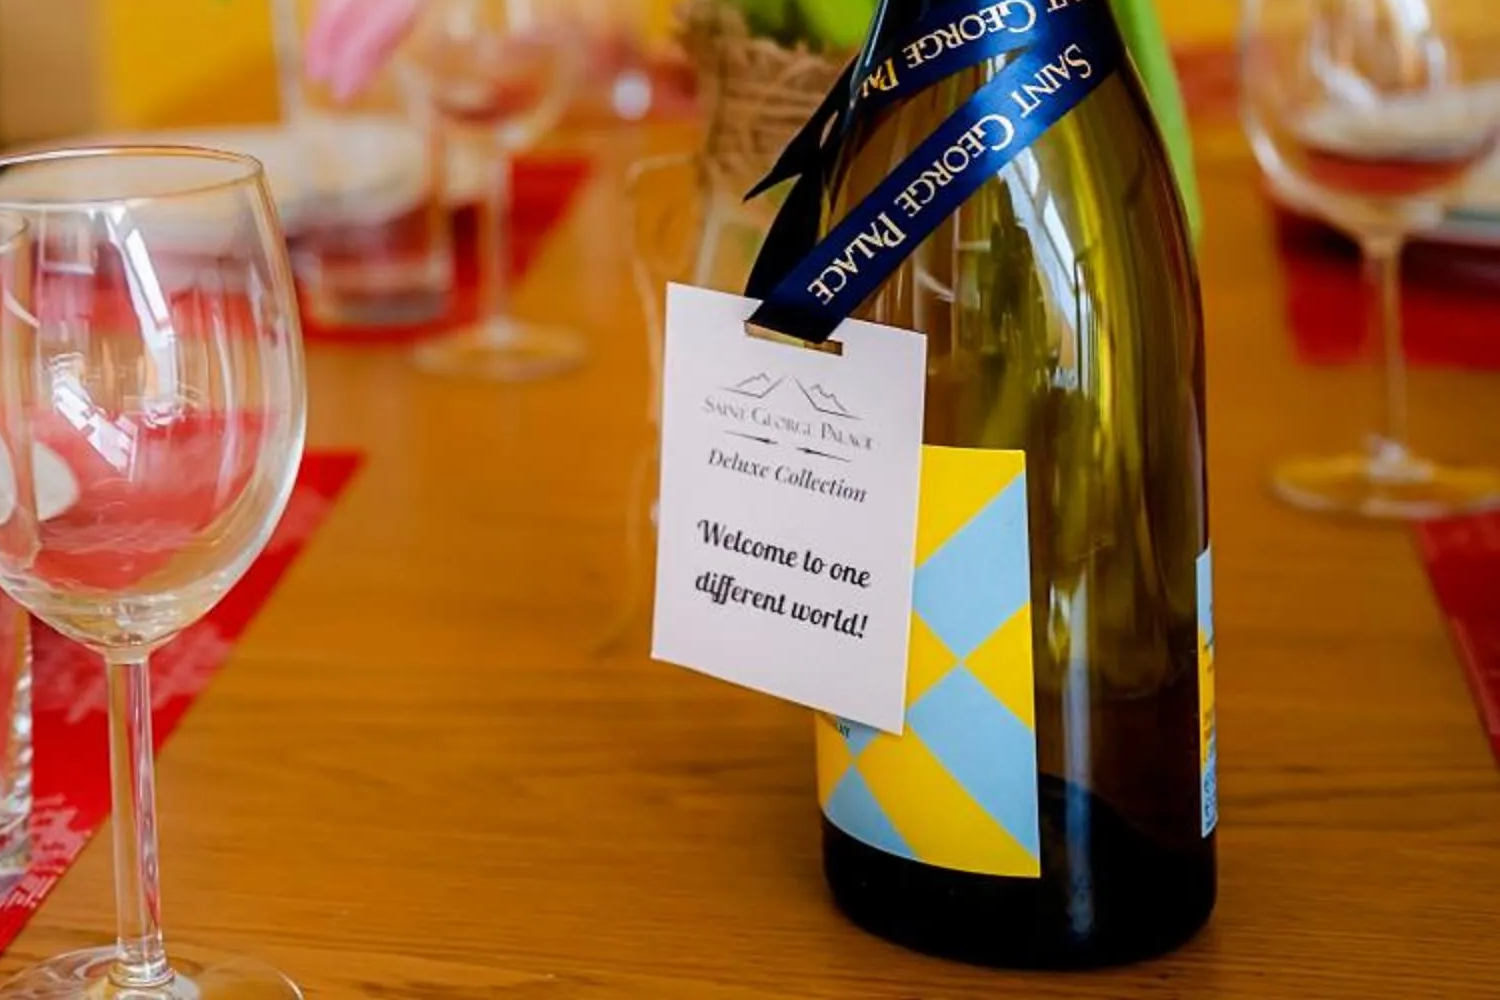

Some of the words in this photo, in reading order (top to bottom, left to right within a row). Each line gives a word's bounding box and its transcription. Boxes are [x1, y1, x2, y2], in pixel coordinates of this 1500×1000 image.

[1010, 44, 1093, 119] SAINT
[893, 112, 1015, 218] GEORGE
[806, 211, 907, 305] PALACE
[708, 447, 770, 479] Deluxe
[774, 464, 868, 503] Collection
[696, 518, 799, 569] Welcome
[802, 550, 827, 575] to
[829, 562, 872, 589] one
[695, 571, 786, 615] different
[791, 600, 869, 640] world!
